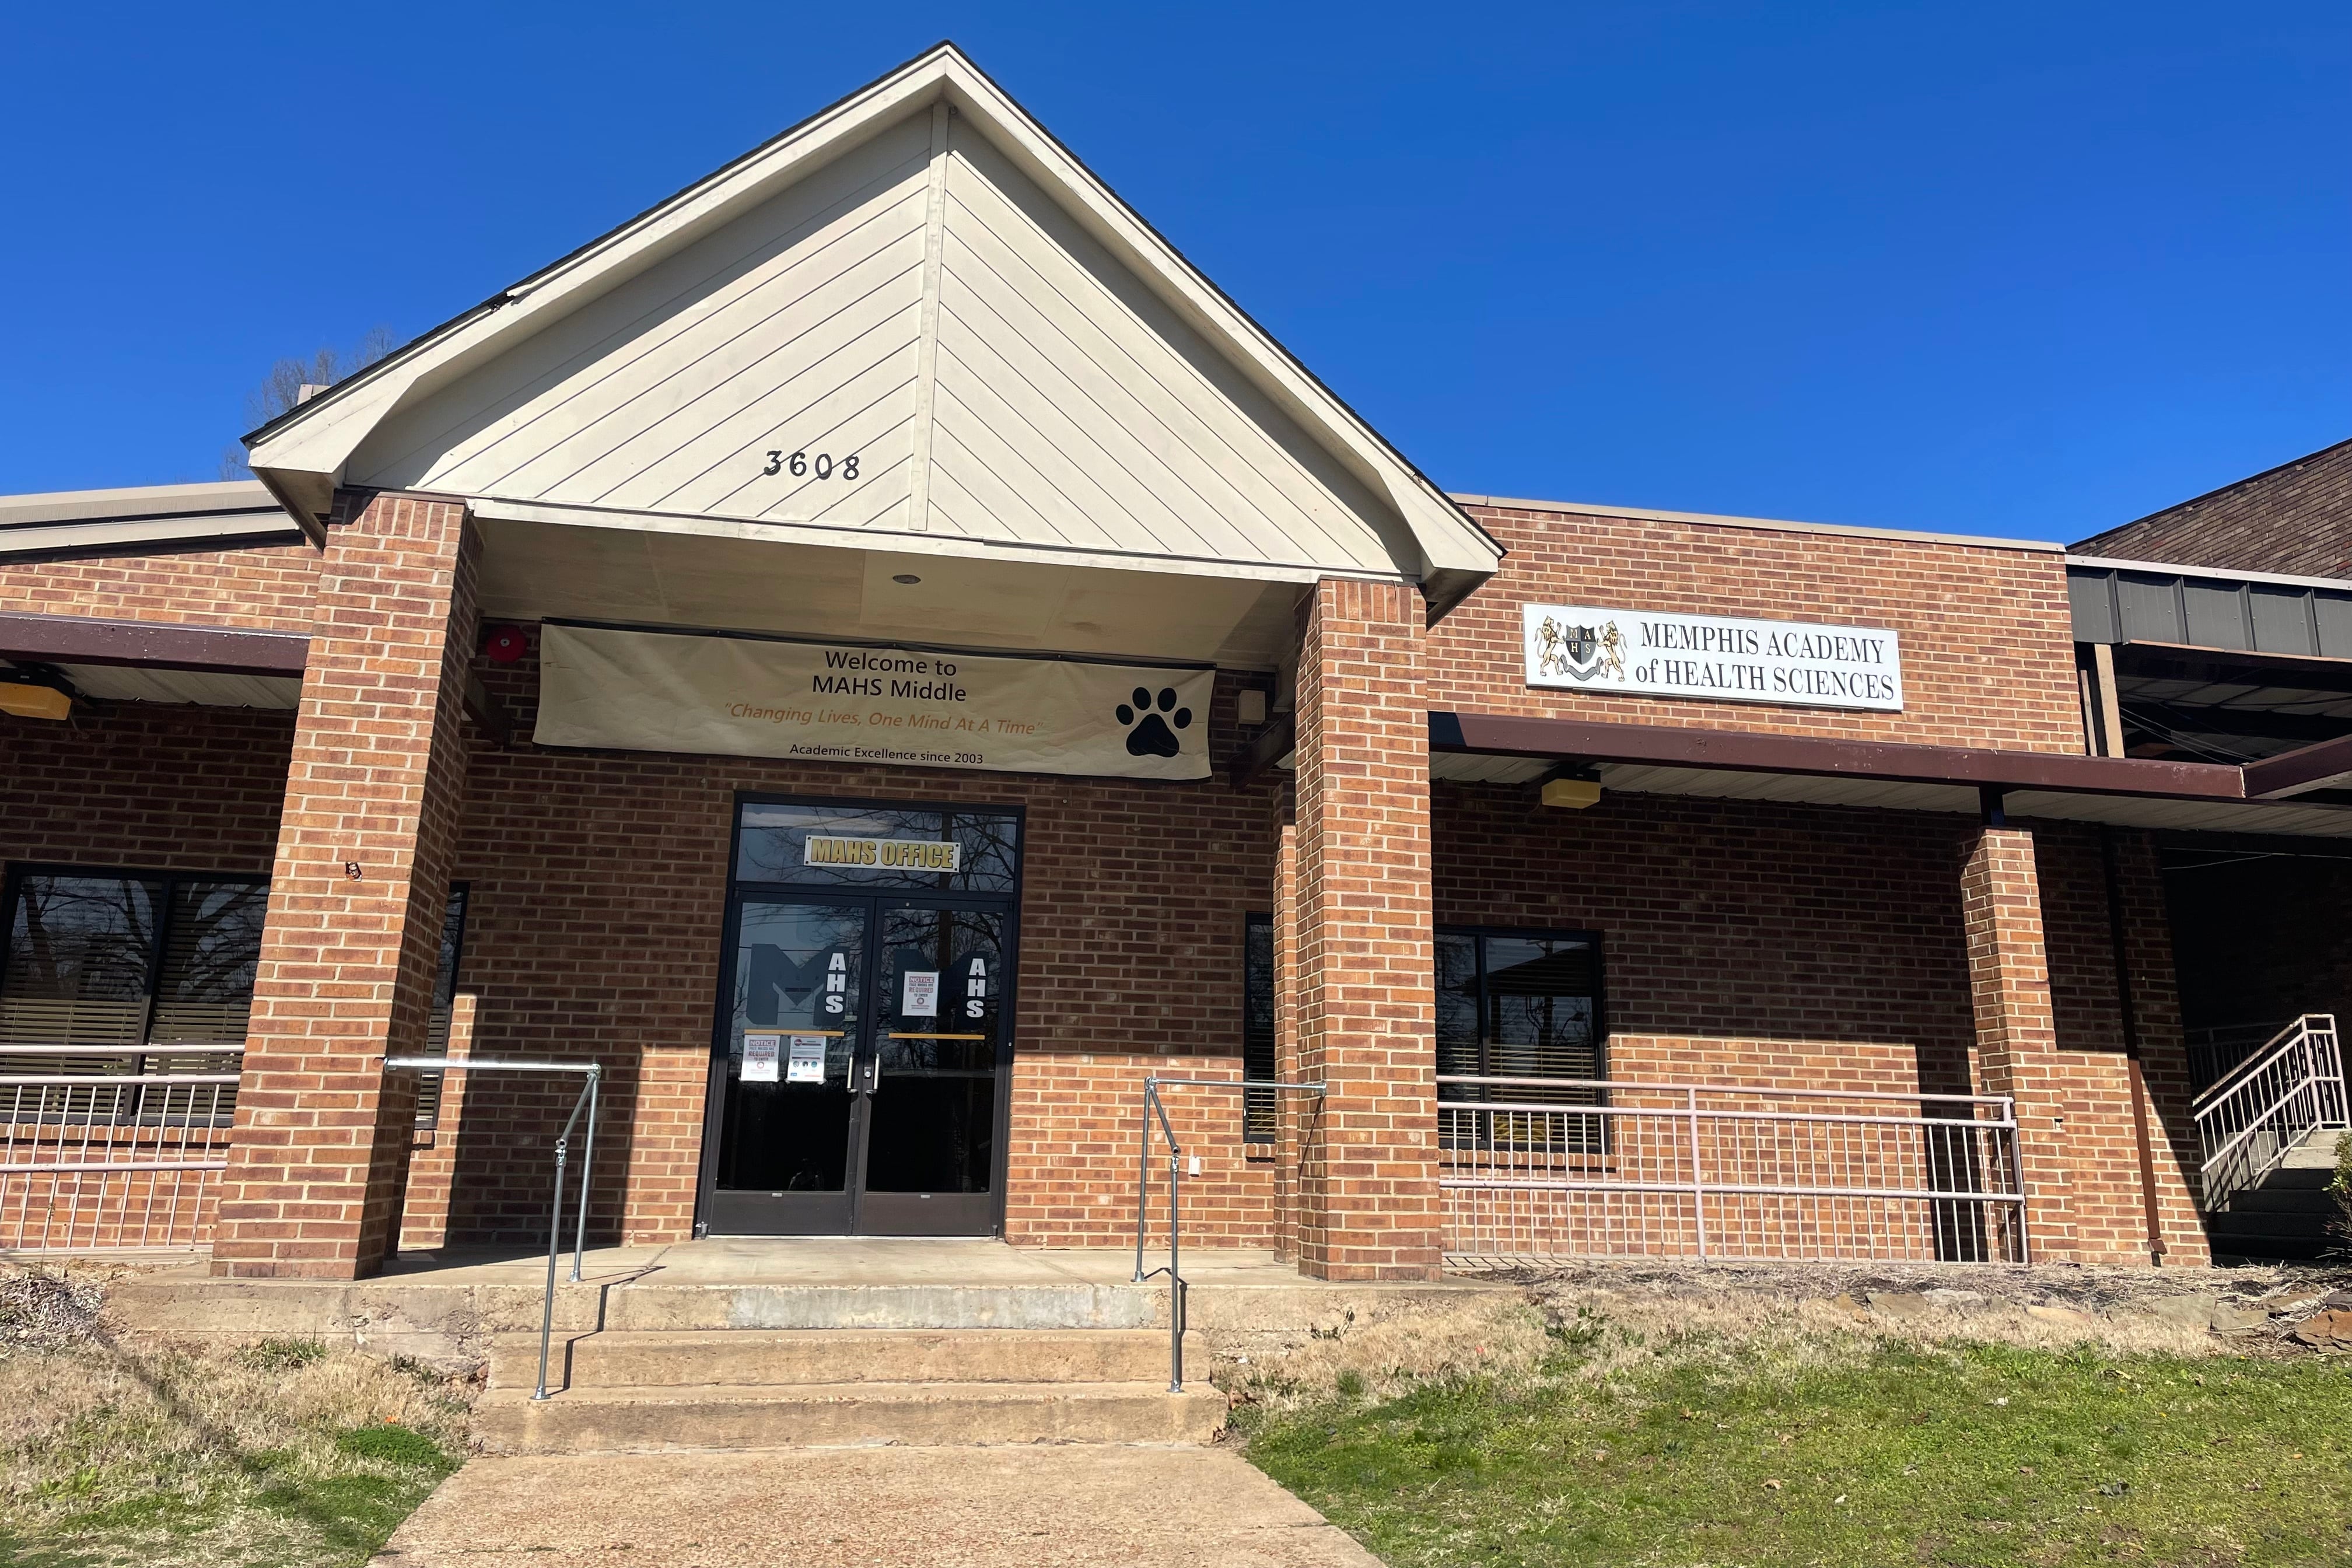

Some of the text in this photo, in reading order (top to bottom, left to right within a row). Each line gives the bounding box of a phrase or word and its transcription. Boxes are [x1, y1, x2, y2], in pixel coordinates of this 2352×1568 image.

[764, 450, 859, 480] 3608
[1570, 629, 1591, 640] M A
[1640, 622, 1884, 664] MEMPHIS ACADEMY
[1571, 642, 1591, 653] H S
[825, 651, 957, 676] Welcome to
[813, 676, 967, 701] MAHS Middle
[1636, 659, 1894, 700] of HEALTH SCIENCES
[818, 709, 862, 726] Lives,
[869, 712, 902, 726] One
[908, 714, 951, 729] Mind
[954, 718, 975, 731] At
[978, 719, 989, 732] A
[789, 744, 983, 764] Academic Excellence since 2003
[811, 839, 954, 868] MAHS OFFICE
